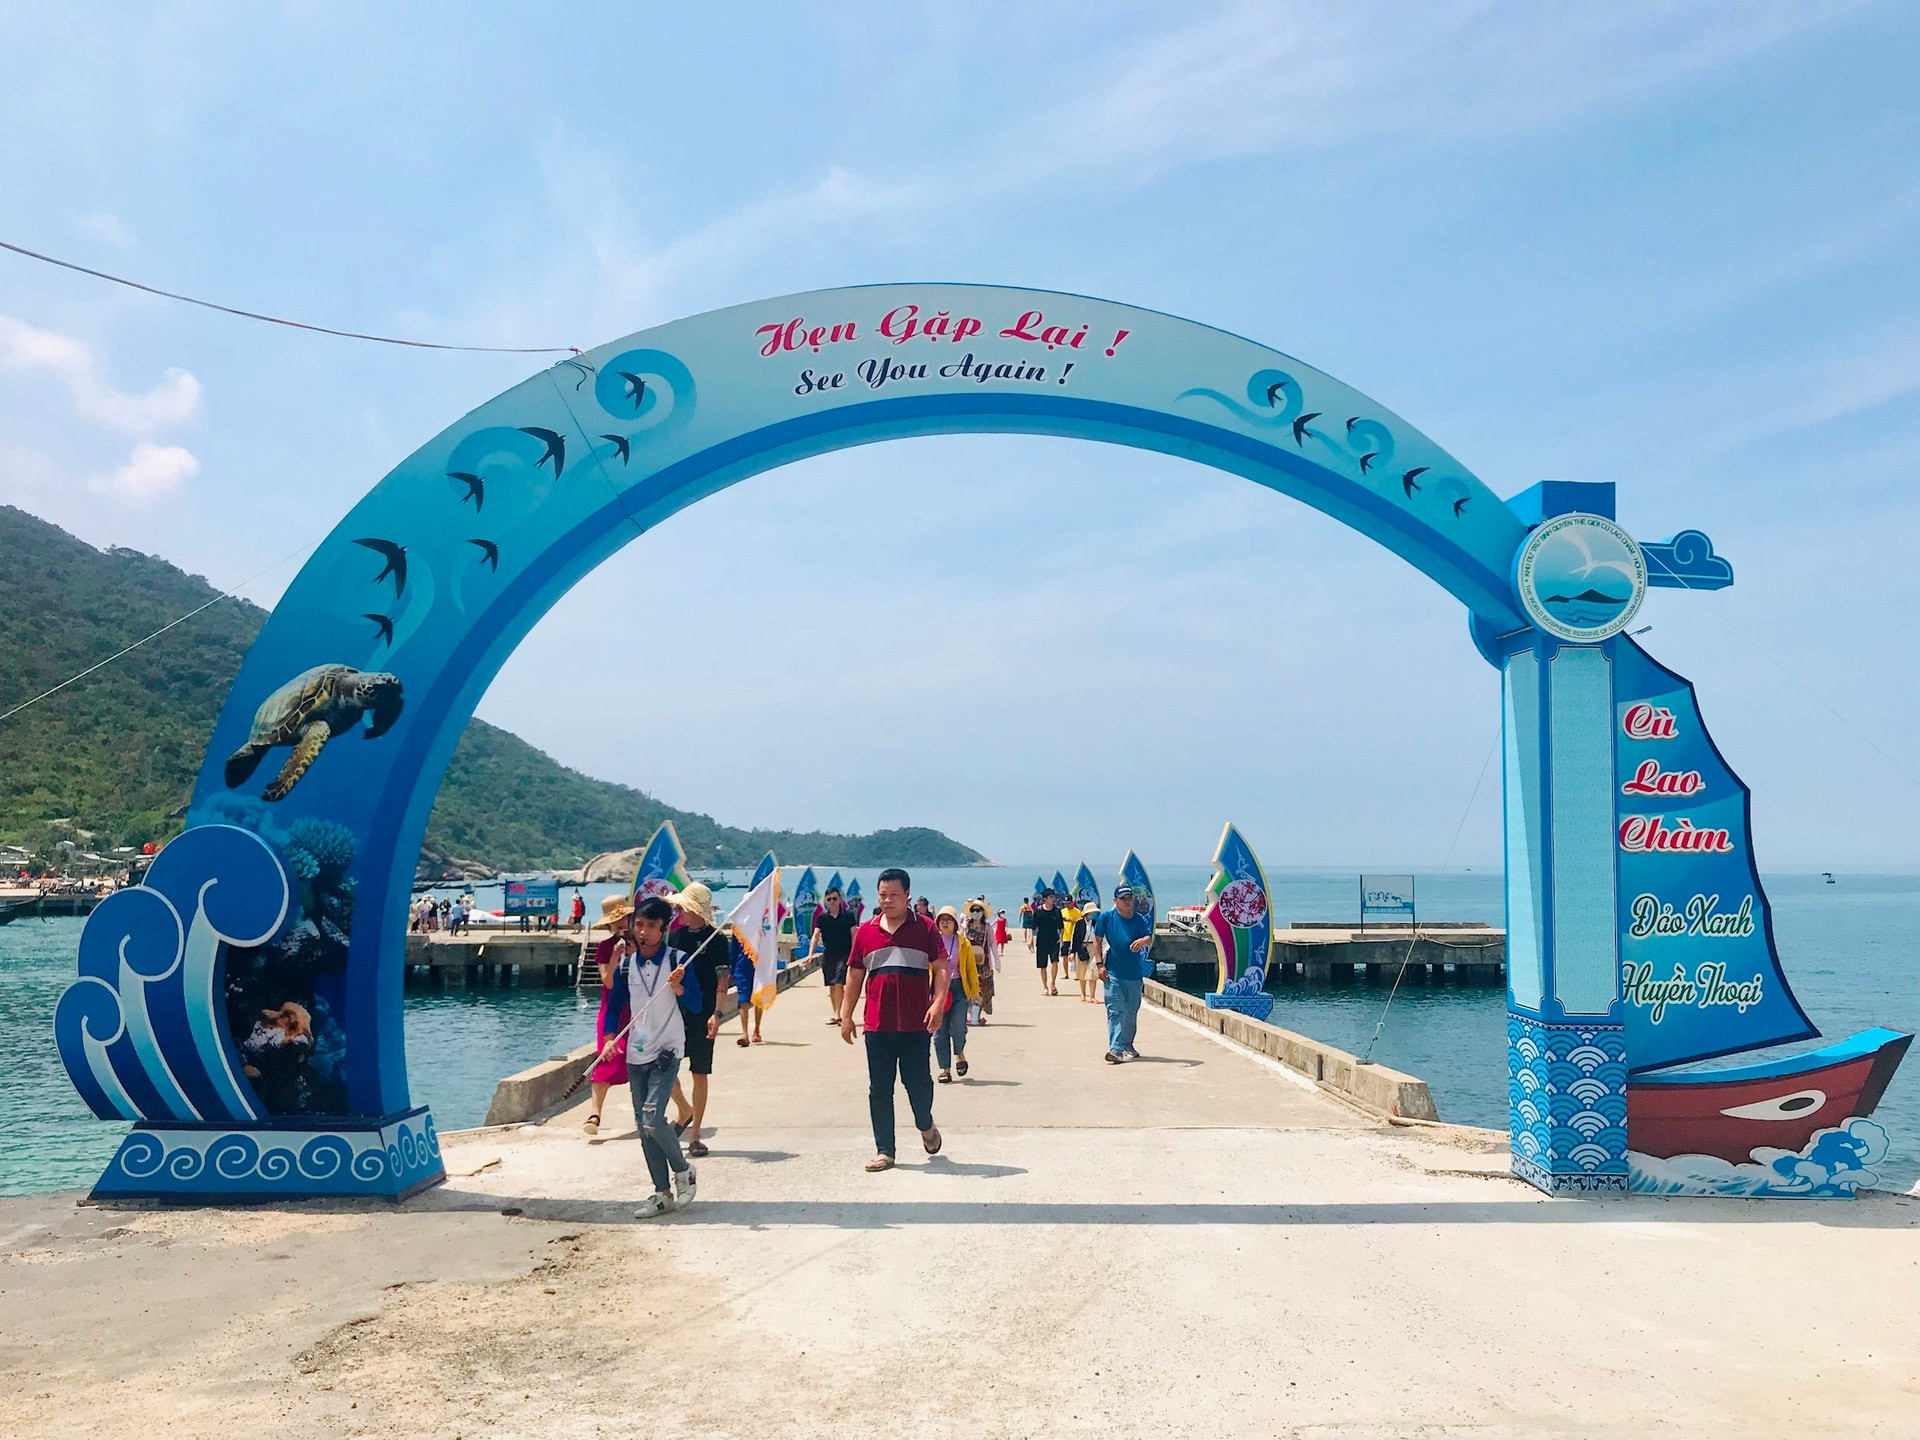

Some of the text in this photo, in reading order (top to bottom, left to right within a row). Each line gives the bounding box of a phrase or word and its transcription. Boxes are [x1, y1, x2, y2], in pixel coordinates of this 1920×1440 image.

[755, 304, 1130, 358] Hẹn Gặp Lại !
[794, 353, 1075, 396] See You Again !
[1624, 704, 1677, 738] Cù
[1623, 760, 1705, 794] Lao
[1620, 817, 1731, 850] Chàm
[1631, 895, 1754, 936] Đảo Xanh
[1623, 963, 1762, 1022] Huyền Thoại
